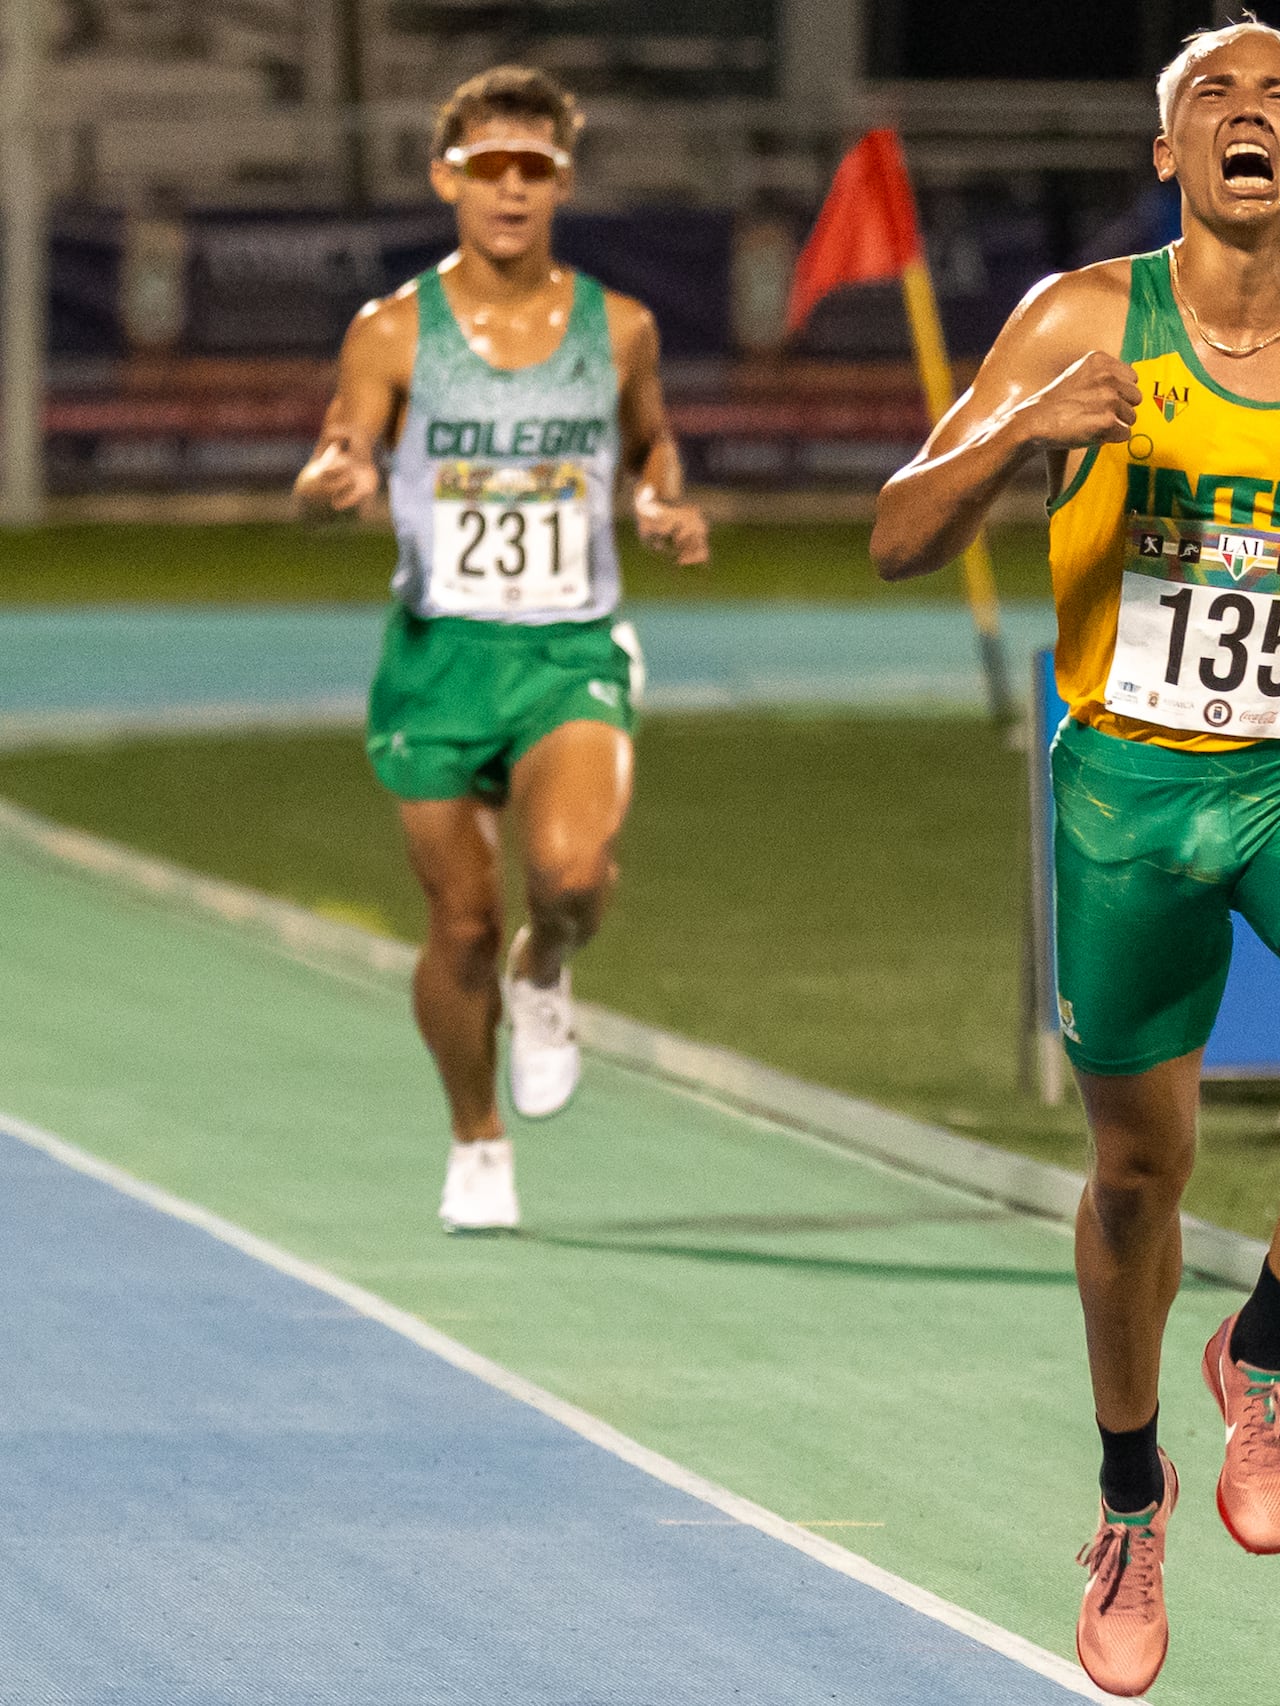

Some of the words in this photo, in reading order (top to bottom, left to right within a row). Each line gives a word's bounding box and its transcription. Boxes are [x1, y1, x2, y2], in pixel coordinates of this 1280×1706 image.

[1153, 381, 1189, 402] LAI
[459, 509, 560, 577] 231
[1223, 537, 1262, 557] LAI
